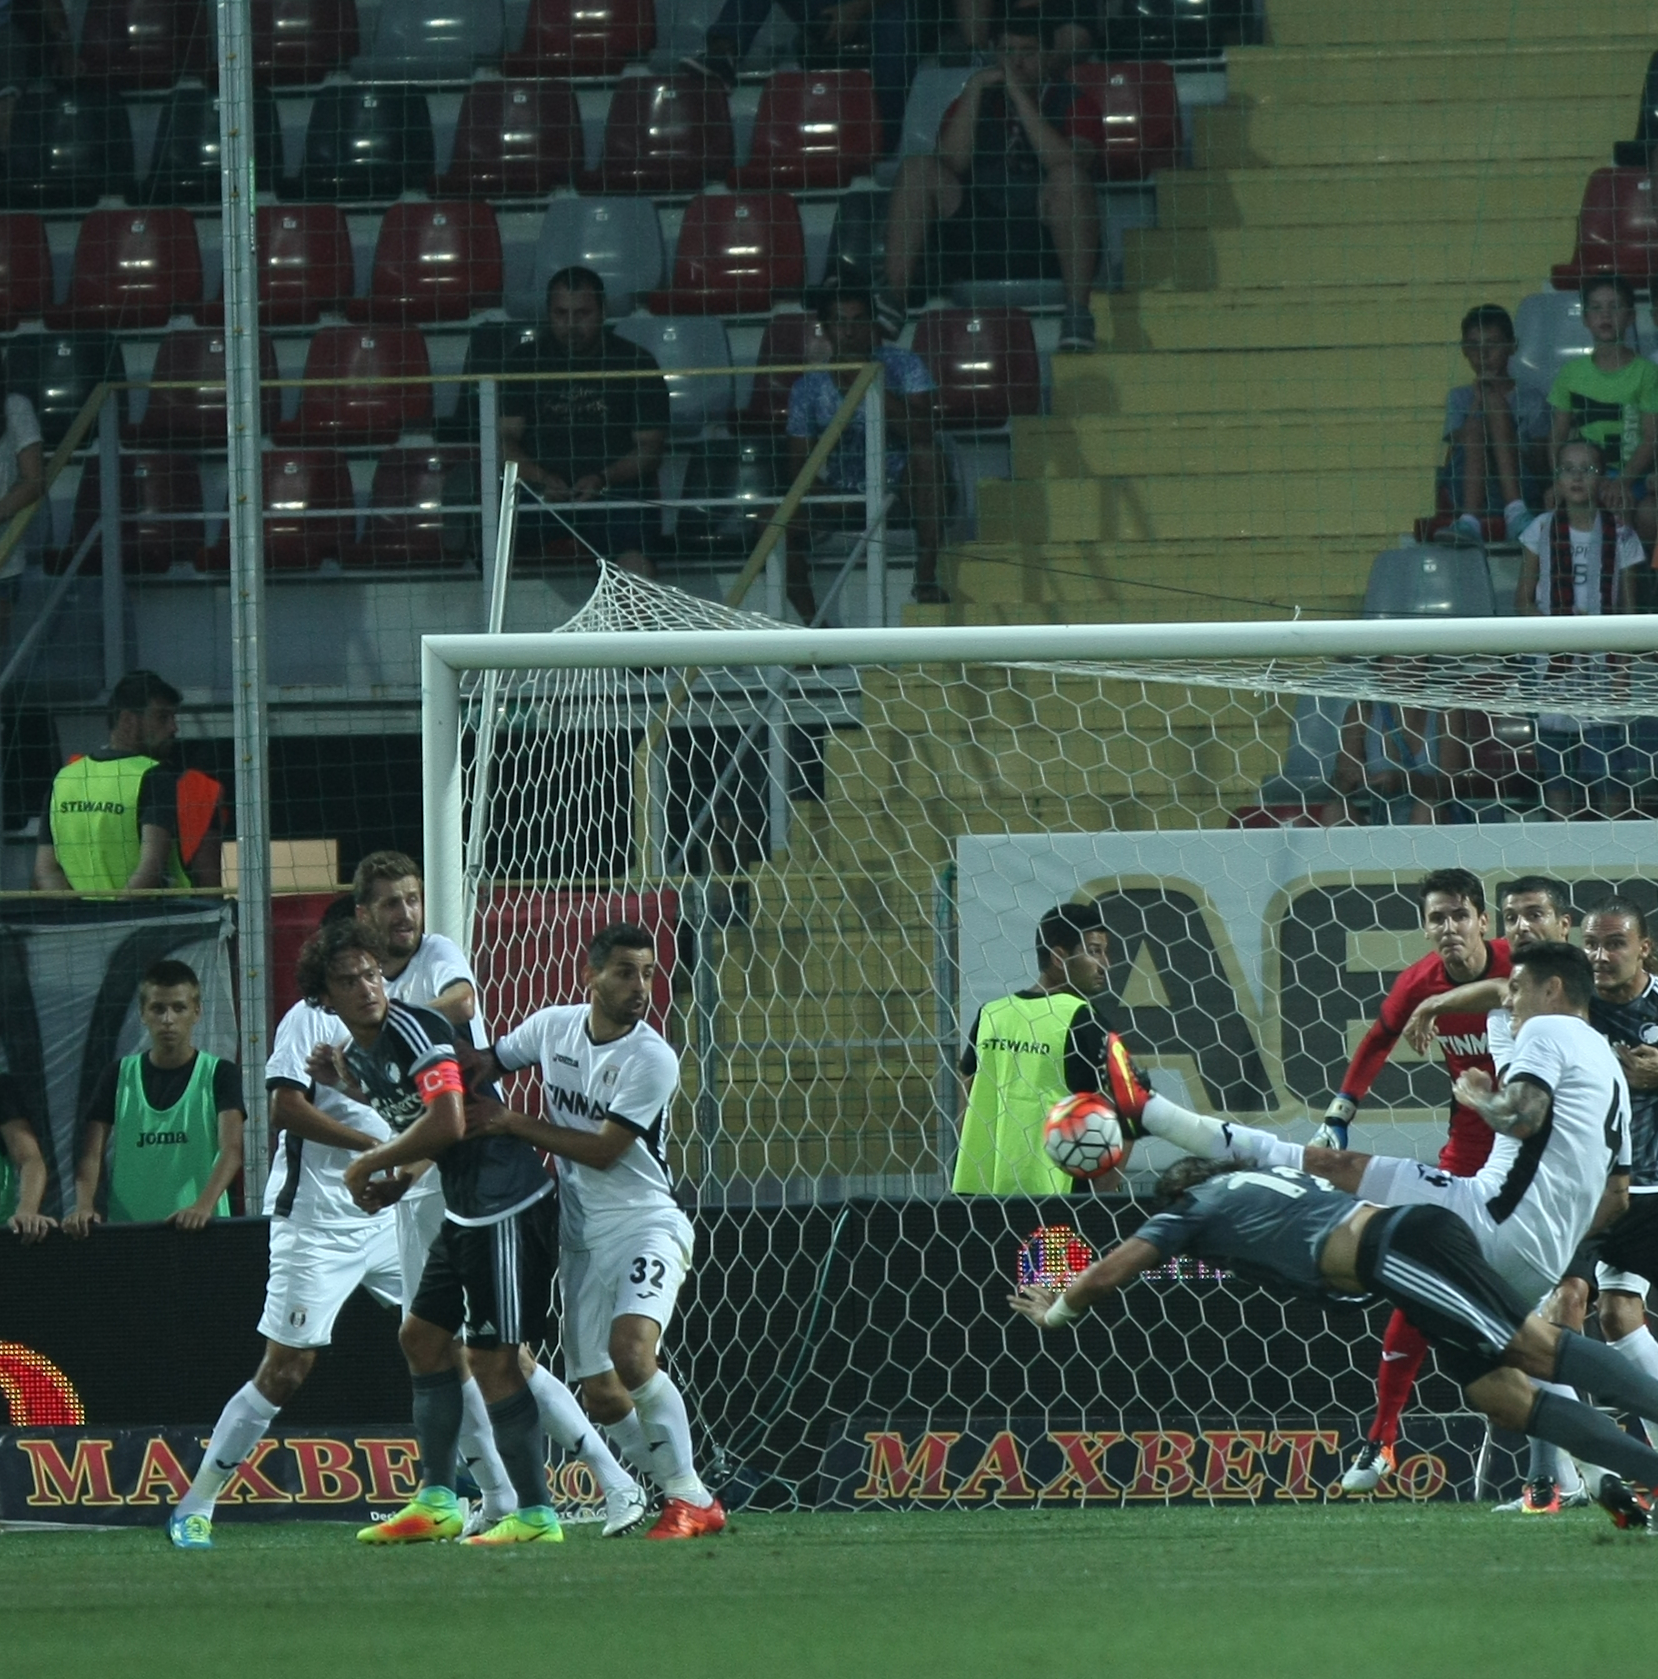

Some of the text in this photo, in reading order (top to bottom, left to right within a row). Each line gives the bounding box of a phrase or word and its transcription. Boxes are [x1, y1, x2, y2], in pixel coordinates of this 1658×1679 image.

[60, 801, 125, 815] STEWARD
[982, 1037, 1051, 1056] STEWARD
[1436, 1032, 1489, 1056] TINM
[423, 1070, 444, 1092] C
[629, 1256, 666, 1290] 32
